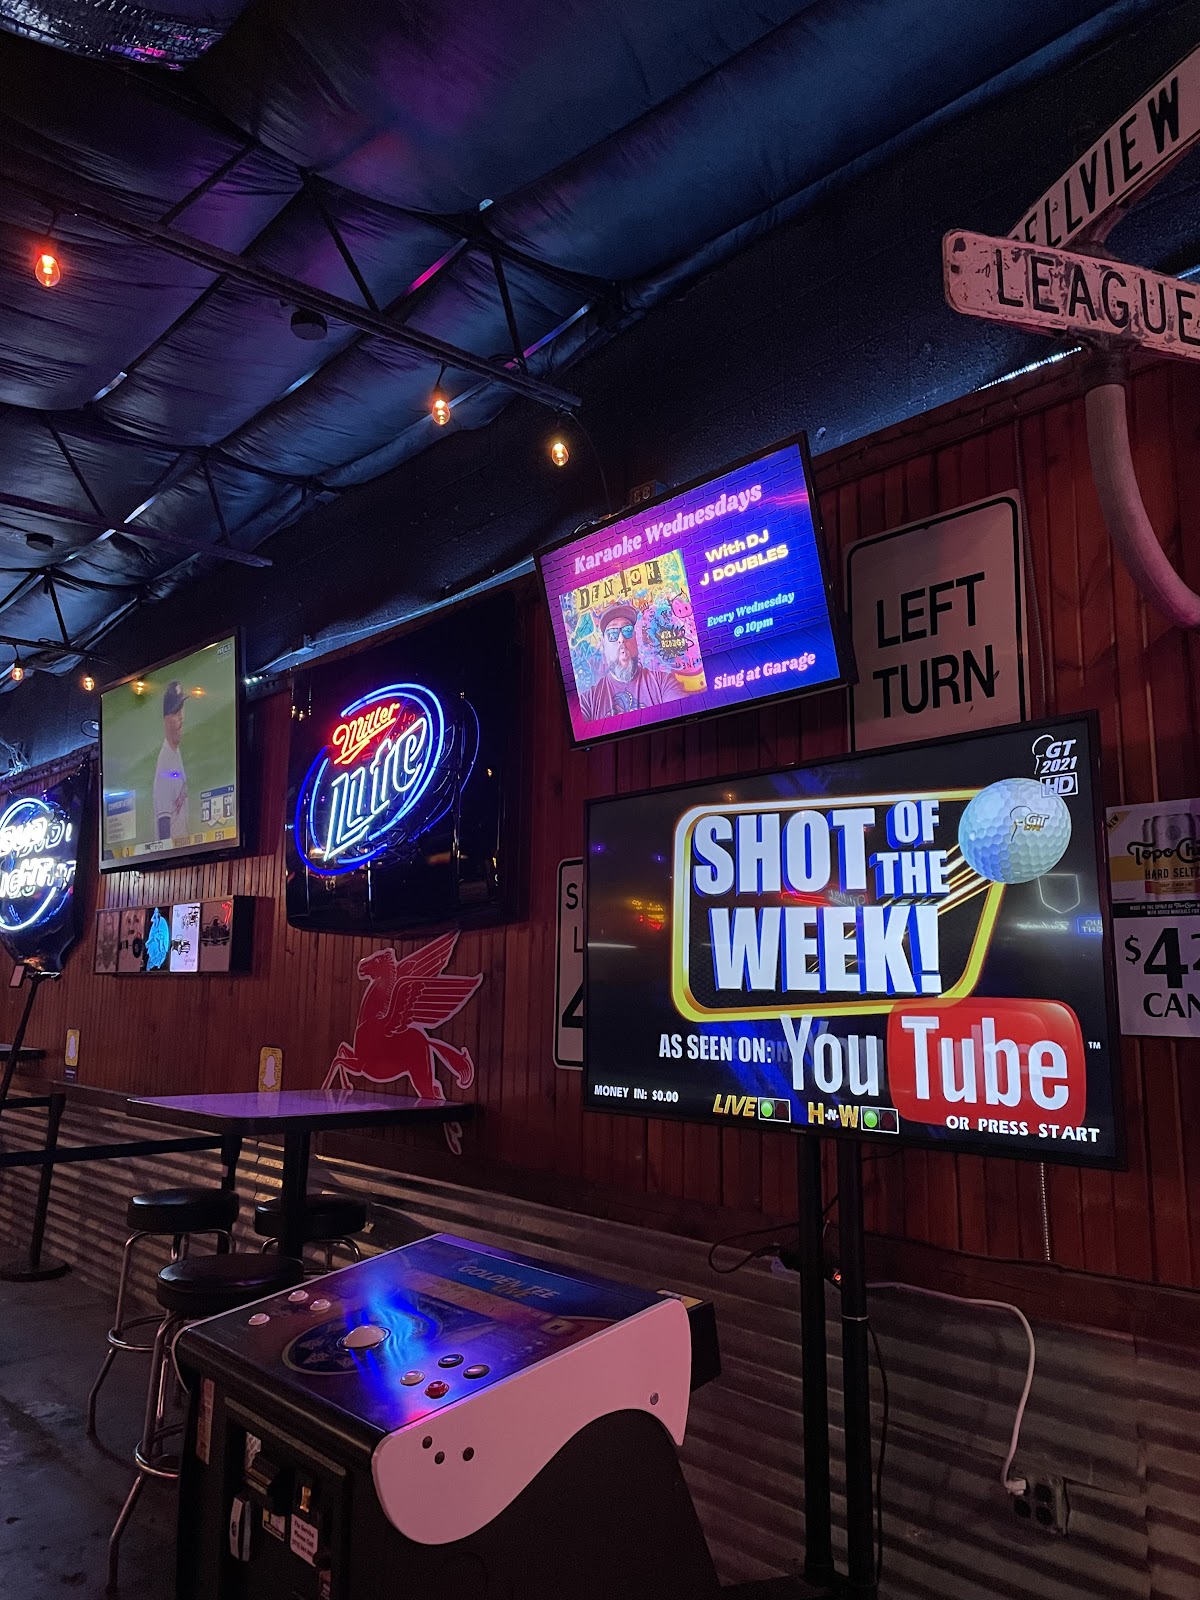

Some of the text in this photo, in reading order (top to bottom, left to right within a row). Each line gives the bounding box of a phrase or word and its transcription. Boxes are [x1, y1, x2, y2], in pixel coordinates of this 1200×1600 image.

[1012, 76, 1180, 249] ELLVIEW
[995, 249, 1200, 346] LEAGUE
[574, 484, 763, 575] Karaoke Wednesdays
[705, 529, 770, 563] With DJ
[699, 544, 789, 587] J DOUBLES
[577, 560, 664, 611] DENTON
[706, 590, 795, 628] Every Wednesday
[876, 571, 985, 648] LEFT
[713, 652, 816, 690] Sing at Garage
[872, 644, 995, 718] TURN
[332, 703, 400, 760] Miller
[1045, 739, 1077, 758] GT
[1040, 756, 1078, 774] 2021
[323, 717, 427, 862] Lite
[1045, 776, 1074, 795] HD
[887, 800, 940, 849] OF
[1106, 814, 1120, 829] NEW
[693, 808, 875, 895] SHOT
[1127, 841, 1174, 866] Topo
[870, 849, 950, 898] THE
[1145, 868, 1169, 880] HARD
[708, 905, 943, 995] WEEK!
[659, 1034, 772, 1063] AS SEEN ON:
[594, 1085, 679, 1103] MONEY IN: $0.00
[712, 1094, 758, 1118] LIVE
[946, 1115, 1100, 1143] OR PRESS START
[458, 1266, 560, 1299] GOLDEN TEE
